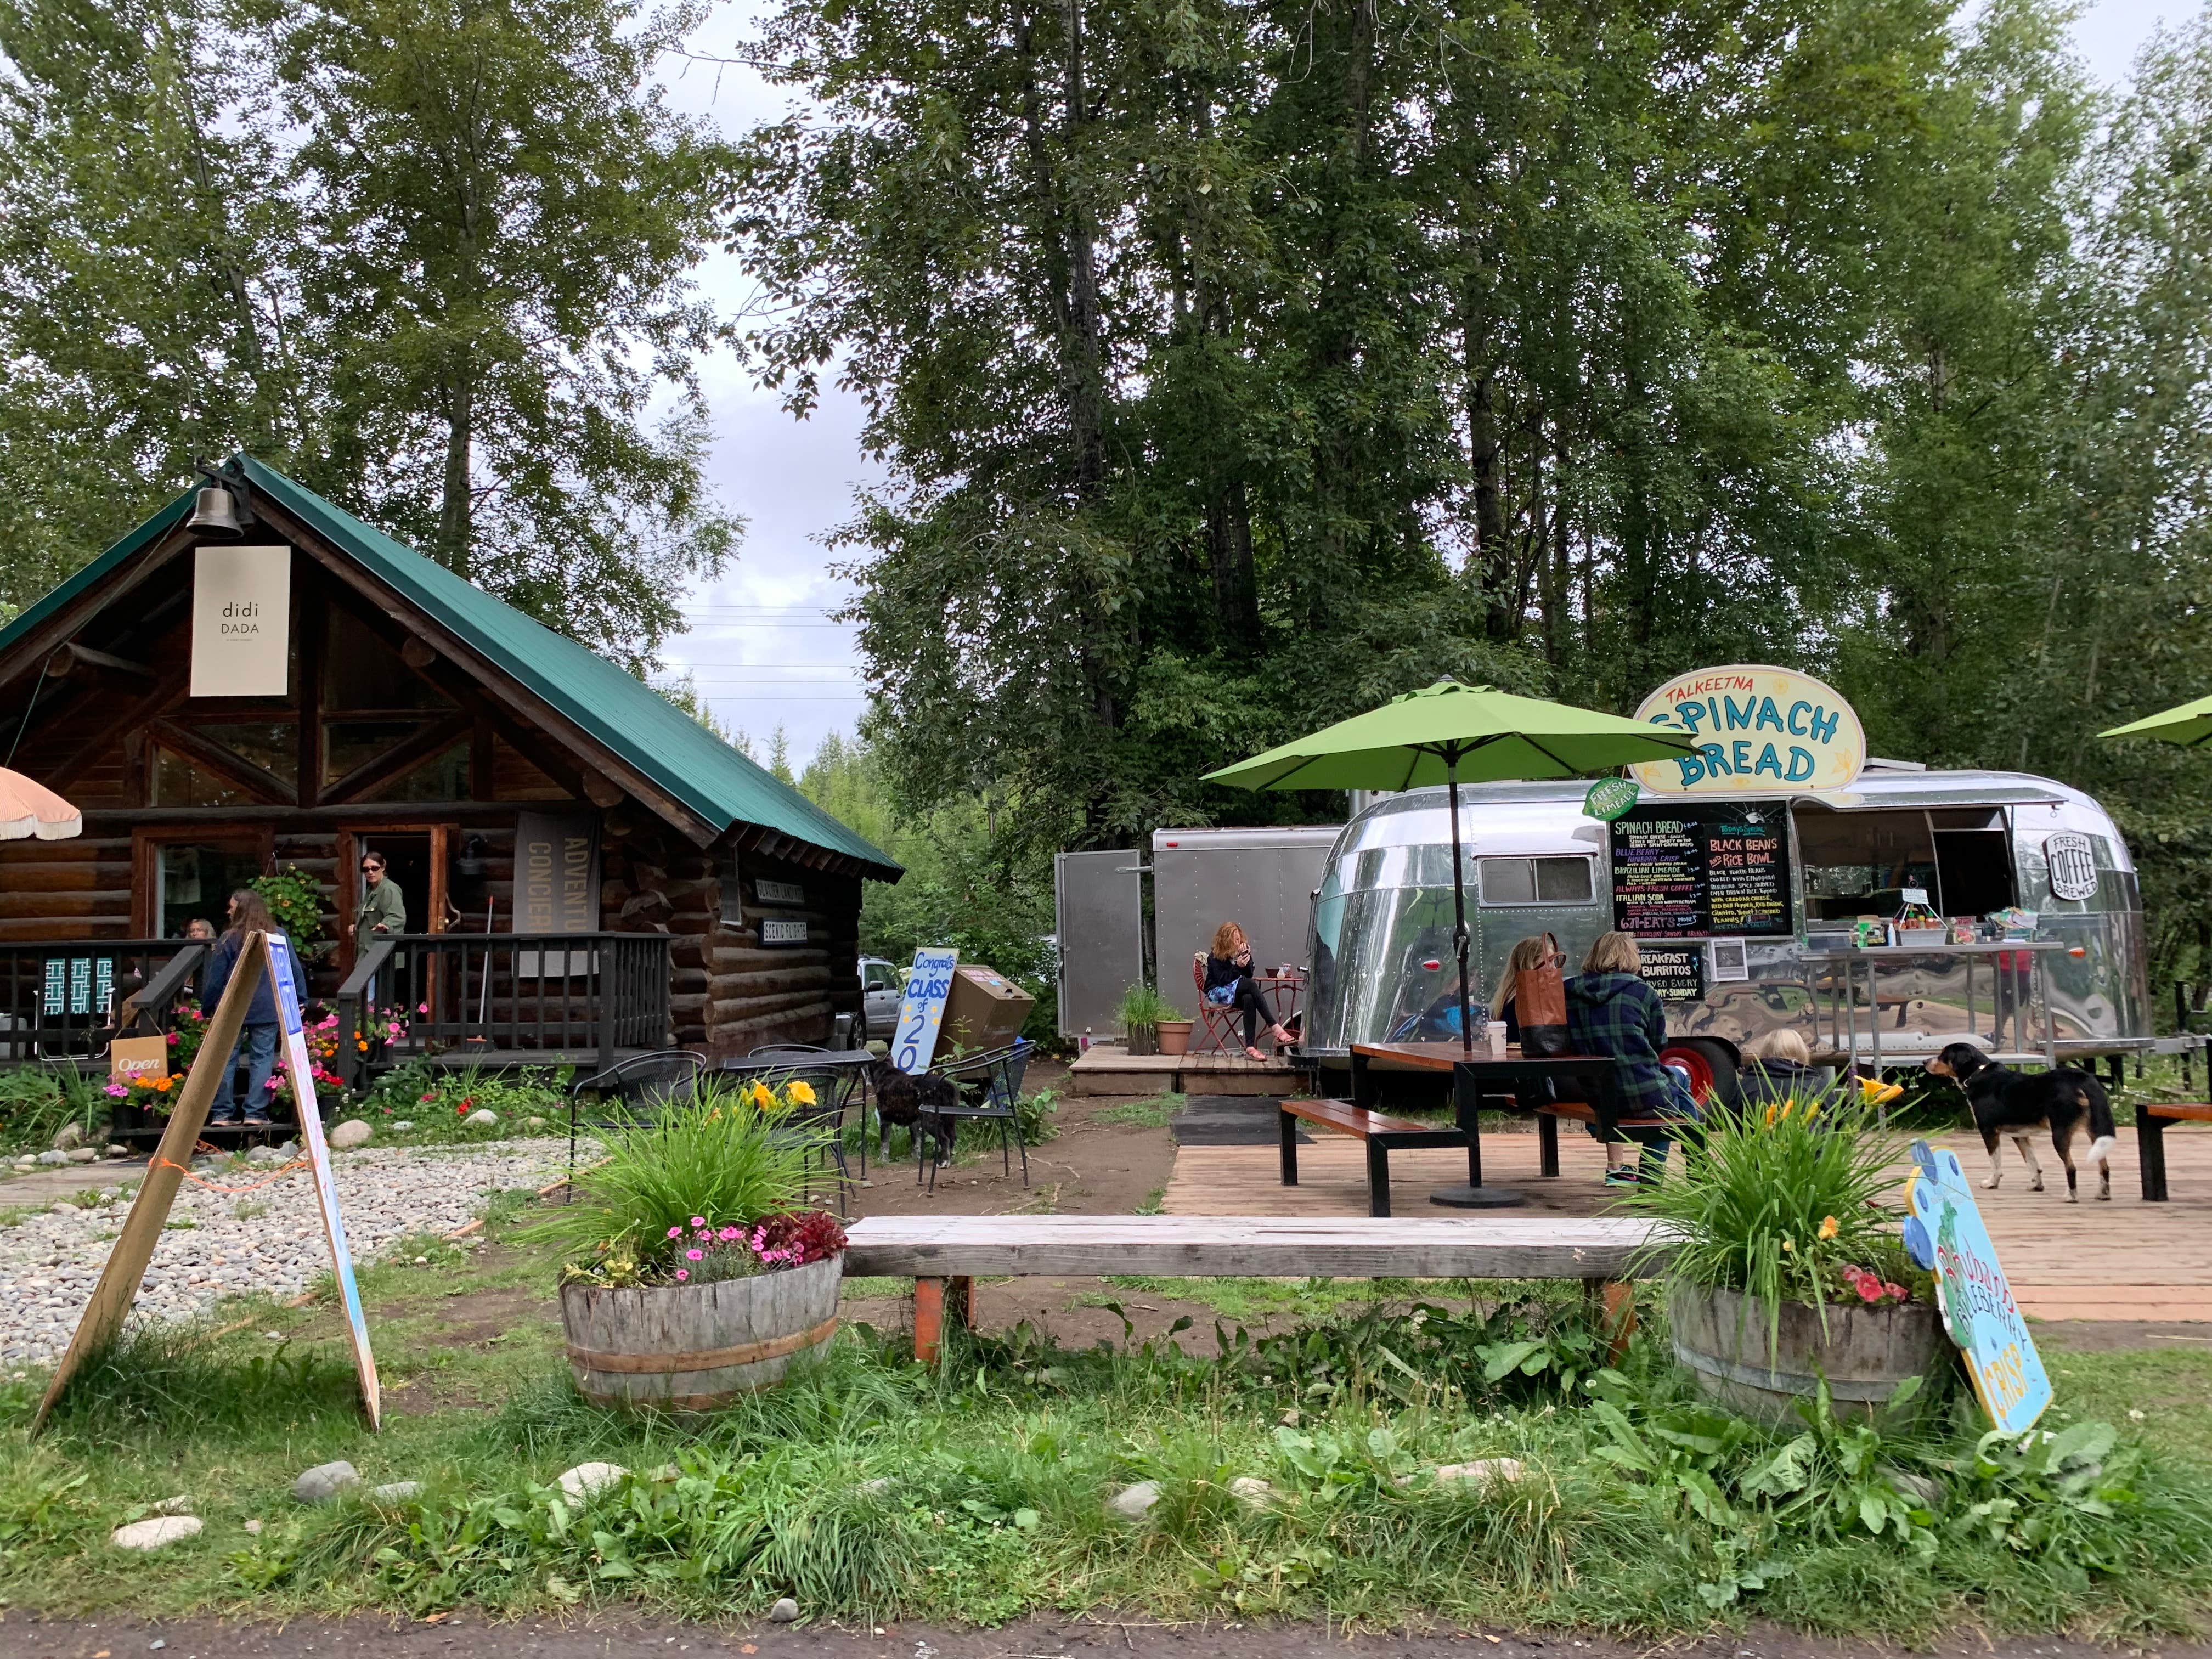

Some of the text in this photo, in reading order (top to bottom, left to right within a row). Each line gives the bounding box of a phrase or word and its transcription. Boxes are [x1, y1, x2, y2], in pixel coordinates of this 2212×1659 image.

[222, 601, 258, 617] didi
[221, 623, 259, 634] DADA
[1665, 675, 1754, 703] TALKEETNA
[1672, 740, 1815, 787] BREAD
[1589, 781, 1626, 805] FRESH
[1594, 788, 1637, 816] LIMEADE
[1615, 821, 1652, 835] SPINACH
[1656, 821, 1684, 834] BREAD
[1709, 838, 1778, 851] BLACK BEANS
[2053, 837, 2086, 850] FRESH
[1709, 855, 1722, 866] AND
[1747, 852, 1775, 865] BOWL
[2051, 848, 2094, 884] COFFEE
[1615, 866, 1650, 874] BRAZILIAN
[528, 842, 552, 933] CONCIER
[565, 838, 589, 930] ADVENTU
[2056, 881, 2098, 898] BREWED
[1616, 894, 1646, 902] ITALIAN
[1647, 893, 1664, 901] SODA
[1620, 916, 1675, 929] 671-EATS
[765, 923, 806, 939] SCENIC FLIGHTS
[915, 951, 955, 977] Congrats
[1640, 953, 1689, 964] REAKFAST
[1641, 965, 1691, 977] BURRITOS
[907, 978, 950, 999] CLASS
[1643, 979, 1697, 988] RVED EVERY
[917, 997, 928, 1013] of
[118, 1058, 160, 1072] Open
[1956, 1284, 2028, 1351] BLUEBERRY
[1984, 1342, 2029, 1419] CRISP
